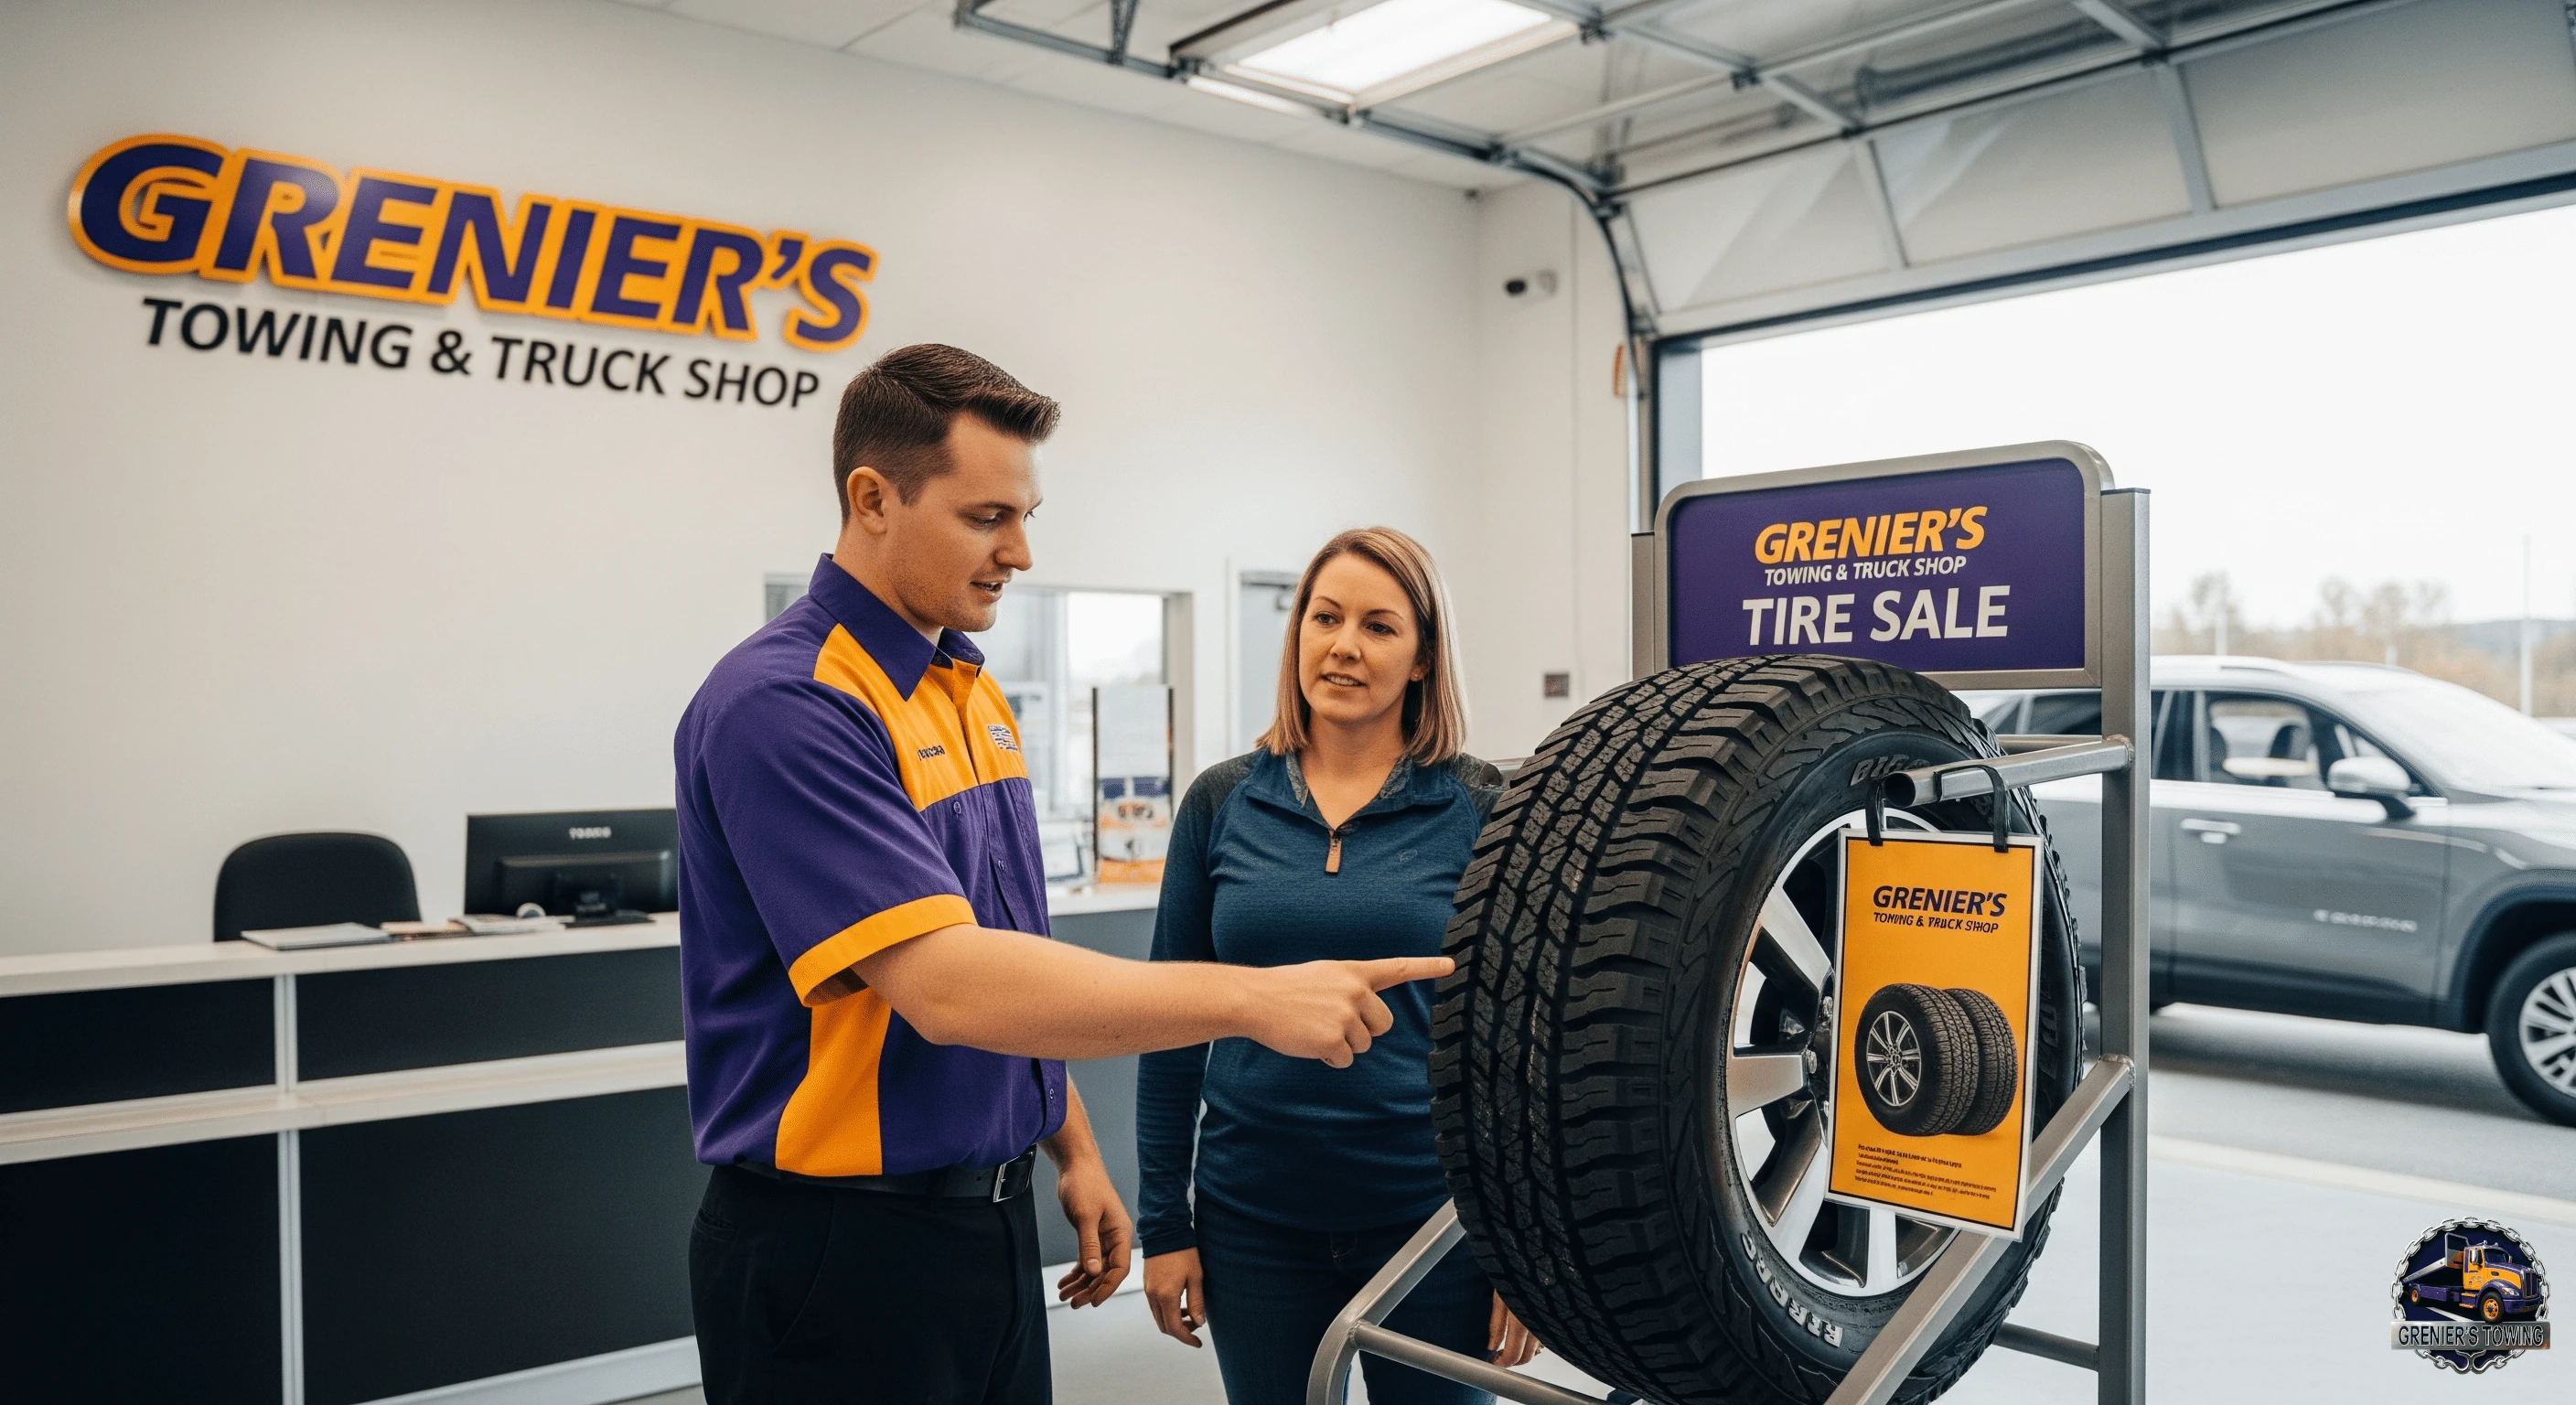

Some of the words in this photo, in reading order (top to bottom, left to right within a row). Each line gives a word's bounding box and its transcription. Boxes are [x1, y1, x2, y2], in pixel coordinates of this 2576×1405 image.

[69, 134, 879, 352] GRENIER'S
[142, 296, 413, 370] TOWING
[430, 329, 472, 375] &
[491, 336, 671, 395] TRUCK
[684, 359, 820, 408] SHOP
[1755, 506, 1988, 564] GRENIER'S
[1765, 563, 1832, 586] TOWING
[1835, 563, 1848, 581] &
[1852, 558, 1911, 580] TRUCK
[1914, 555, 1967, 576] SHOP
[1742, 594, 1855, 646] TIRE
[1870, 585, 2011, 641] SALE
[1873, 885, 2008, 917] GRENIER'S
[1916, 916, 1925, 928] &
